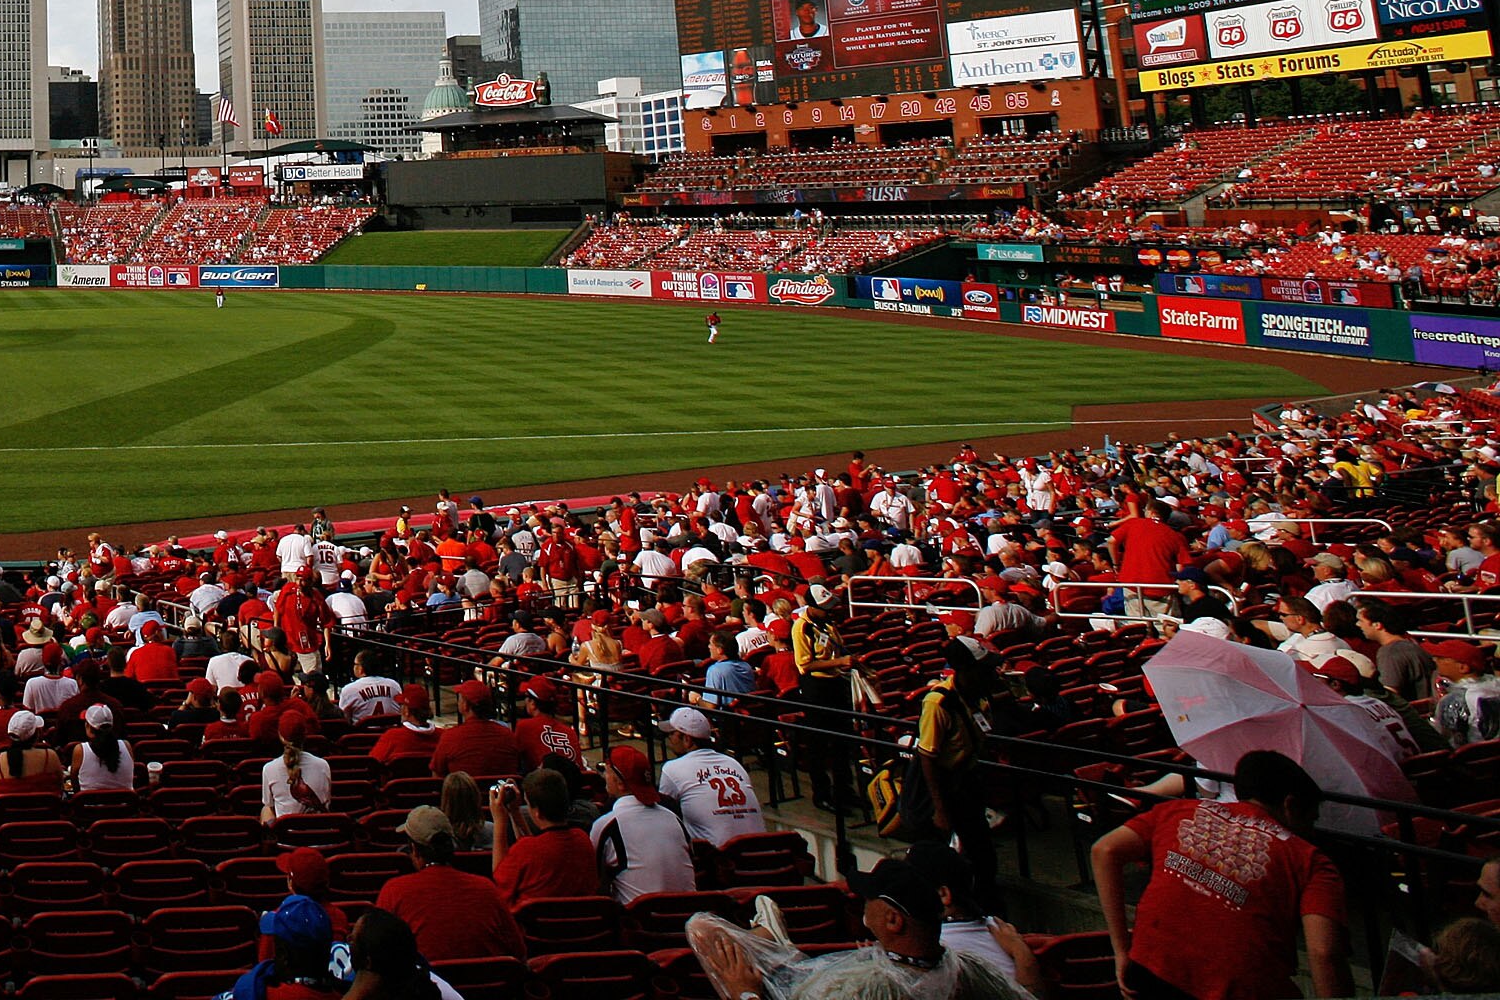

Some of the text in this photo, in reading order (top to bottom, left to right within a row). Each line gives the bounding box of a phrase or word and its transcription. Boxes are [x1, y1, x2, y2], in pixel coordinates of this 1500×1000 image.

[1130, 6, 1161, 20] Welcome
[1163, 7, 1172, 15] to
[1173, 3, 1187, 12] the
[1188, 0, 1211, 10] 2009
[1330, 0, 1357, 11] PHILLIPS
[1271, 10, 1297, 19] PHILLIPS
[1333, 11, 1357, 27] 66
[856, 25, 881, 33] PLAYED
[1218, 18, 1241, 28] PHILLIPS
[1274, 21, 1297, 35] 66
[841, 34, 874, 43] CANADIAN
[875, 30, 909, 39] NATIONAL
[991, 39, 1023, 47] JOHN'S
[1025, 35, 1056, 44] MERCY
[1220, 28, 1242, 43] 66
[846, 43, 866, 51] WHILE
[897, 37, 927, 45] SCHOOL.
[785, 50, 821, 60] FUTURES
[958, 58, 1035, 79] Anthem
[1158, 53, 1341, 88] Blogs Stats Forums
[730, 93, 1029, 128] 1 2 6 9 14 17 20 42 45 85
[285, 166, 361, 179] BJC Better Health
[872, 187, 904, 201] USA
[72, 274, 106, 286] Ameren
[117, 273, 147, 281] OUTSIDE
[201, 271, 275, 281] BUD LIGHT
[573, 277, 588, 286] Bank
[597, 278, 623, 287] America
[672, 271, 697, 282] THINK
[661, 281, 698, 292] OUTSIDE
[970, 292, 987, 303] Ford
[874, 300, 931, 314] BUSCH STADIUM
[1042, 308, 1108, 329] MIDWEST
[1162, 308, 1238, 330] State Farm
[1261, 313, 1368, 338] SPONGETECH.com
[1263, 328, 1297, 339] AMERICA'S
[1298, 331, 1330, 343] CLEANING
[319, 551, 334, 563] 16
[358, 686, 391, 701] MOLINA
[697, 768, 711, 784] Hot
[708, 776, 747, 807] 23
[1166, 850, 1249, 897] WORLD SERIES
[1164, 859, 1247, 906] CHAMPIONS
